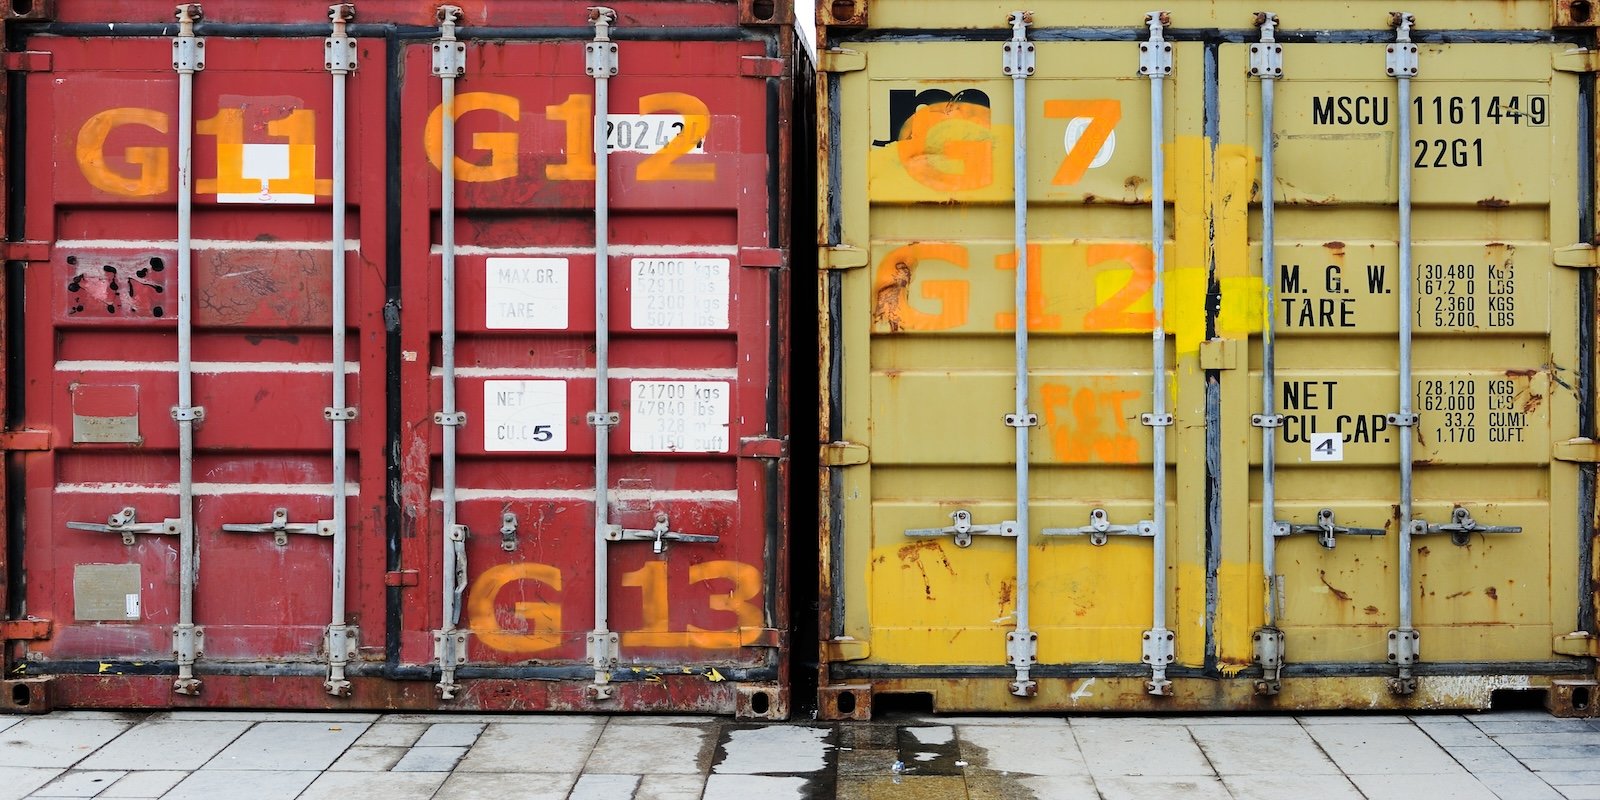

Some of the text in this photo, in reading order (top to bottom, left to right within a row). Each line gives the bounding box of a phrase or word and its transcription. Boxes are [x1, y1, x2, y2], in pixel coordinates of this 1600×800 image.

[1312, 96, 1389, 126] MSCU
[1415, 138, 1483, 168] 22G1
[638, 260, 720, 280] 24000 kgs
[1281, 264, 1391, 294] M. G. W.
[498, 302, 535, 318] TARE
[647, 295, 720, 314] 2300 kgs
[1281, 298, 1356, 327] TARE
[1488, 296, 1515, 311] KGS
[647, 312, 715, 327] 5071 lbs
[1488, 312, 1515, 327] LBS
[638, 383, 720, 403] 21700 kgs
[1283, 381, 1338, 410] NET
[1488, 380, 1514, 396] KGS
[497, 391, 524, 406] NET
[638, 401, 715, 416] 47840 lbs
[1445, 412, 1475, 427] 33.2
[532, 424, 554, 442] 5
[1336, 415, 1390, 443] CAP.
[1315, 438, 1336, 455] 4
